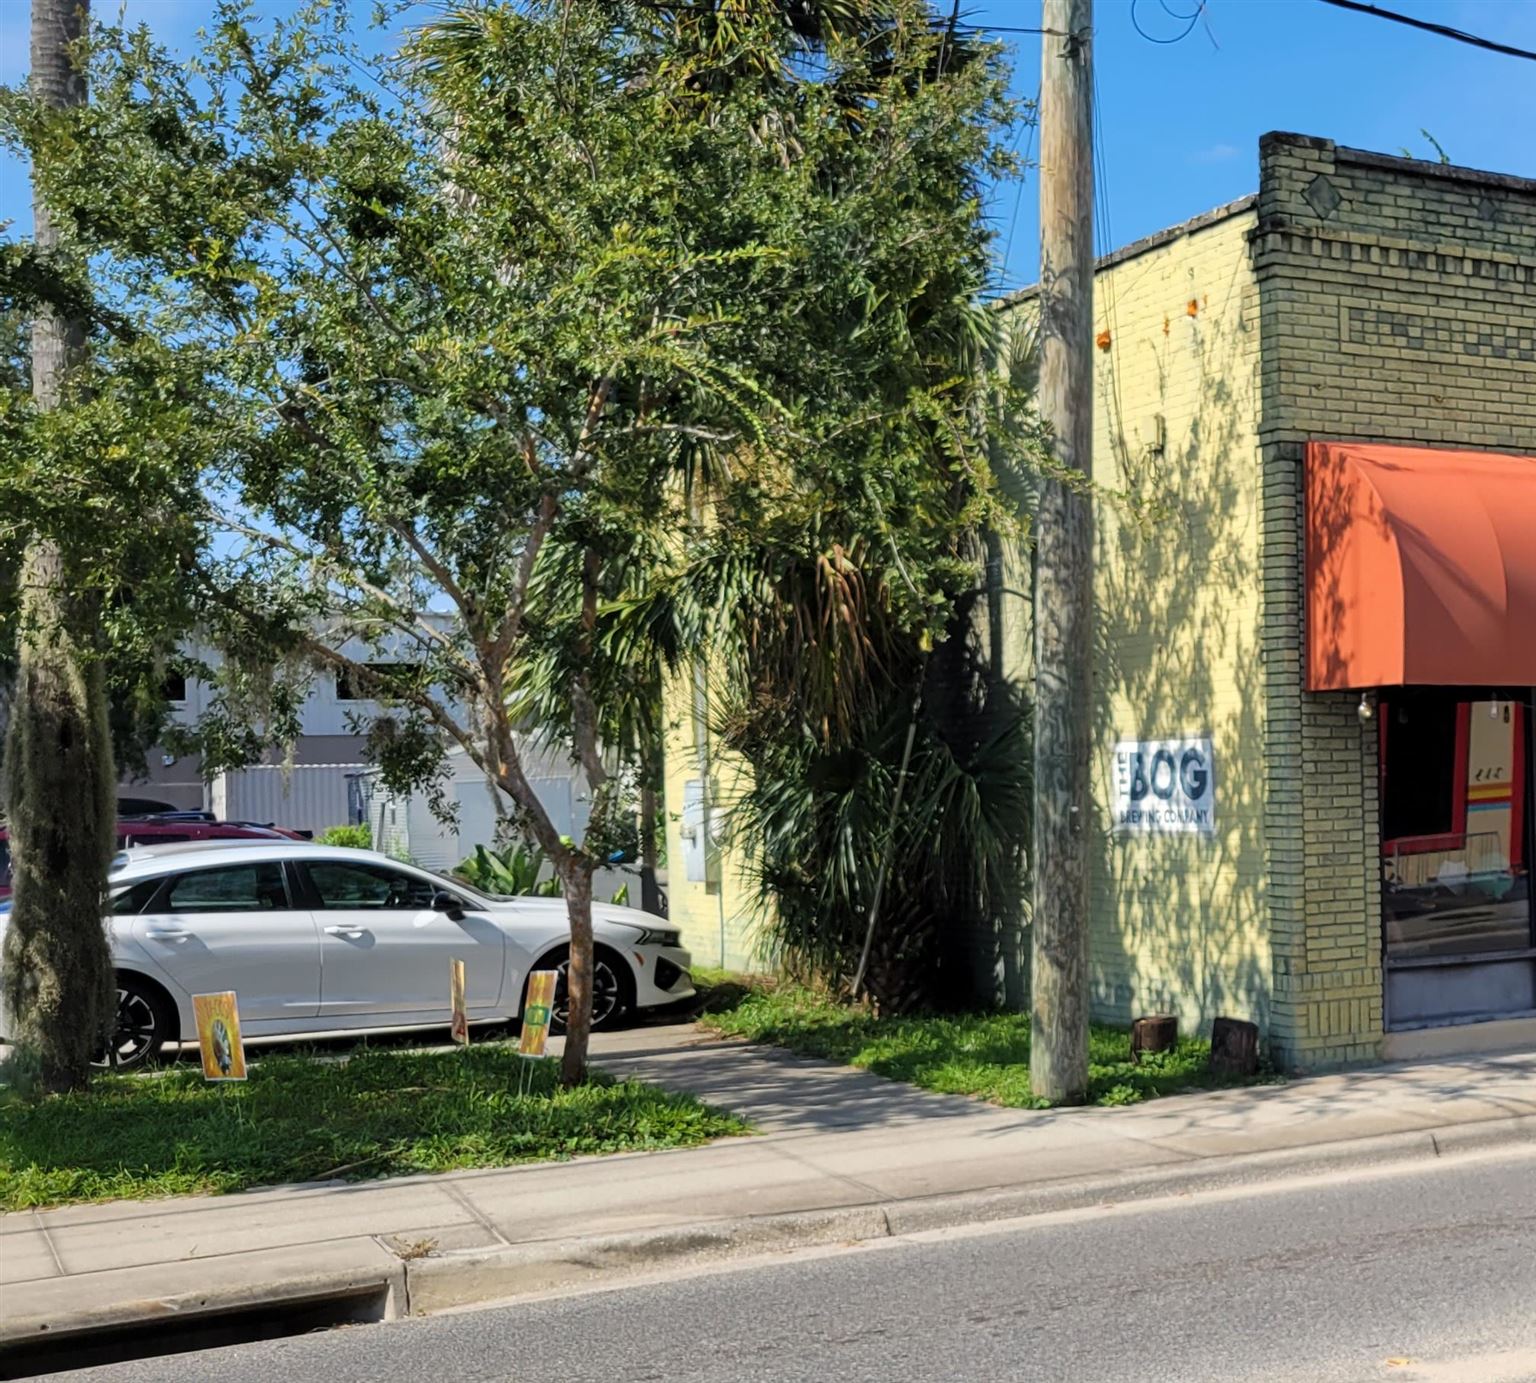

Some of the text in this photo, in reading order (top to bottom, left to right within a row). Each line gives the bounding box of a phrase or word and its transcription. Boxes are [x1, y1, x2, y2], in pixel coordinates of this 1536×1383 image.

[1117, 751, 1128, 796] THE
[1129, 747, 1207, 800] BOG
[1164, 808, 1209, 823] COMPANY
